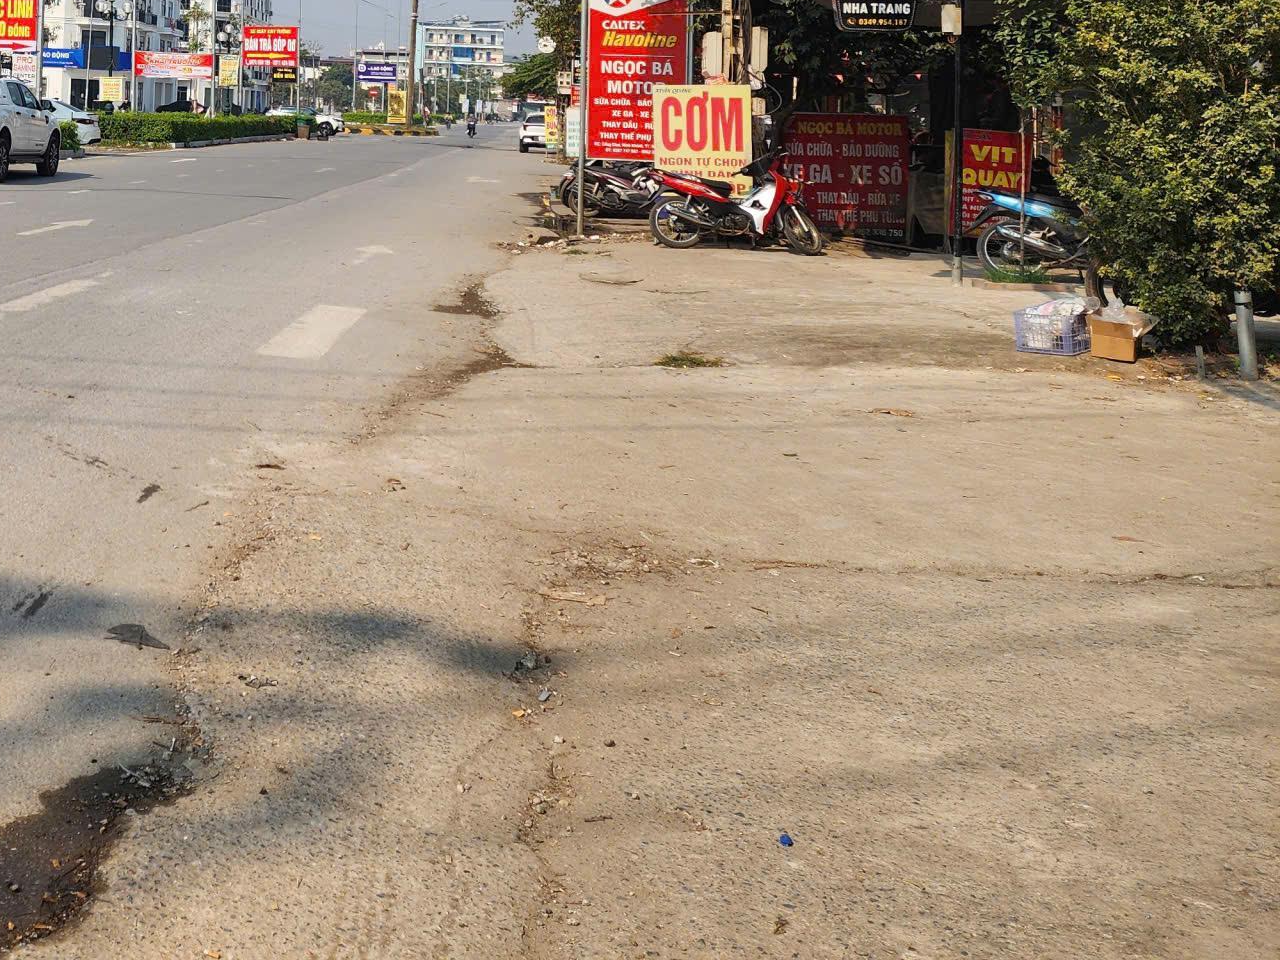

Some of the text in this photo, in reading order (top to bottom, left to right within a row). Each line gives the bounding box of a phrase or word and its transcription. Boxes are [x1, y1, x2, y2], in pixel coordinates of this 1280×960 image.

[7, 0, 34, 18] LINH
[842, 2, 911, 15] NHA TRANG
[601, 20, 645, 30] CALTEX
[602, 31, 678, 48] Havoline
[601, 59, 673, 77] NGỌC BÁ
[607, 80, 665, 94] MOTO
[602, 121, 621, 129] THAY
[661, 91, 744, 152] CƠM
[798, 122, 833, 138] NGỌC
[857, 123, 903, 136] MOTOR
[660, 157, 692, 166] NGON
[971, 144, 1017, 167] VỊT
[809, 164, 833, 184] GA
[850, 165, 873, 185] XE
[879, 159, 903, 185] SỐ
[962, 167, 1023, 189] QUAY
[817, 192, 839, 204] THAY
